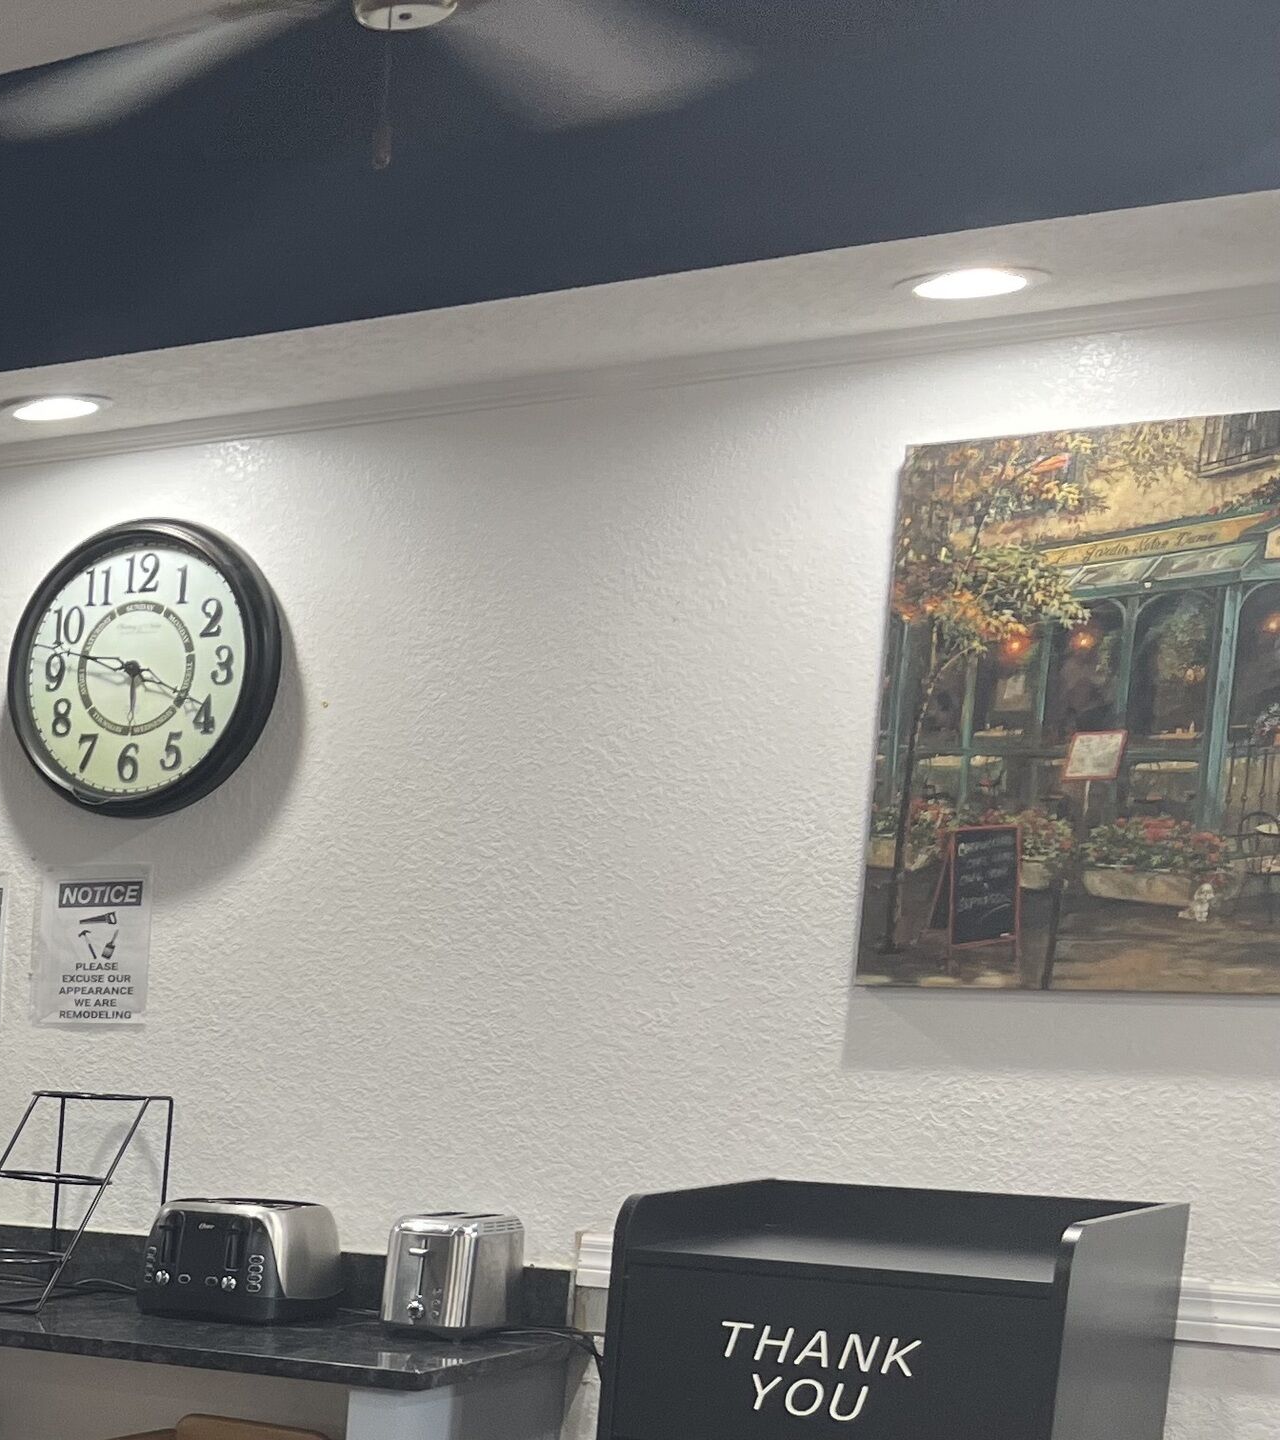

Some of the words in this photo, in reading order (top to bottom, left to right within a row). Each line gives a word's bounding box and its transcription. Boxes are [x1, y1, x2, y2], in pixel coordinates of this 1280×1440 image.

[85, 566, 113, 606] 11
[124, 553, 160, 594] 12
[177, 564, 188, 604] 1
[54, 606, 85, 645] 10
[200, 598, 223, 637] 2
[45, 652, 66, 692] 9
[210, 645, 234, 685] 3
[51, 698, 71, 737] 8
[193, 694, 215, 735] 4
[78, 733, 99, 773] 7
[117, 743, 139, 783] 6
[160, 731, 182, 771] 5
[62, 885, 140, 905] NOTICE
[62, 974, 105, 983] EXCUSE
[107, 974, 131, 983] OUR
[75, 962, 119, 971] PLEASE
[58, 986, 134, 995] APPEARANCE
[74, 998, 91, 1007] WE
[93, 998, 117, 1007] ARE
[59, 1010, 132, 1019] REMODELING
[720, 1320, 923, 1377] THANK
[751, 1374, 869, 1421] YOU
